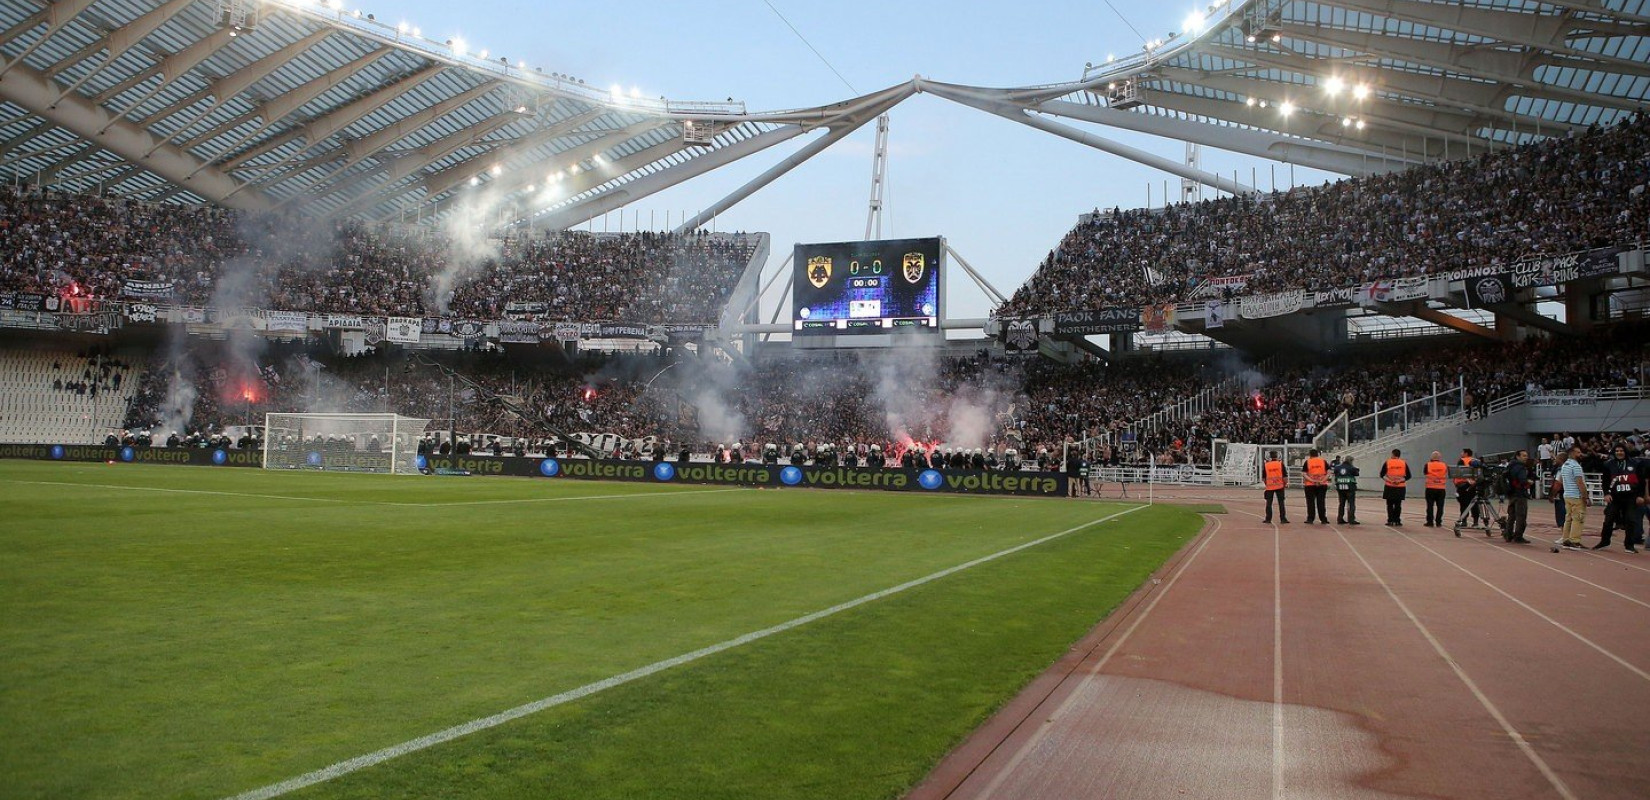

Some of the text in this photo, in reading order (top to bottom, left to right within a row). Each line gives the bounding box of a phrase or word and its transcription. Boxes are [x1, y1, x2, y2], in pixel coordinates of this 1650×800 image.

[849, 261, 859, 275] 0
[872, 259, 882, 274] 0
[853, 279, 878, 287] 00:00
[1058, 308, 1138, 323] PAOK FANS
[1058, 323, 1138, 334] NORTHERNERS
[65, 446, 116, 459] volterra
[135, 447, 190, 461] volterra
[428, 457, 503, 472] voterra
[561, 460, 645, 478] volterra
[677, 465, 770, 483] volterra
[805, 467, 908, 487] volterra
[947, 472, 1057, 492] volterra
